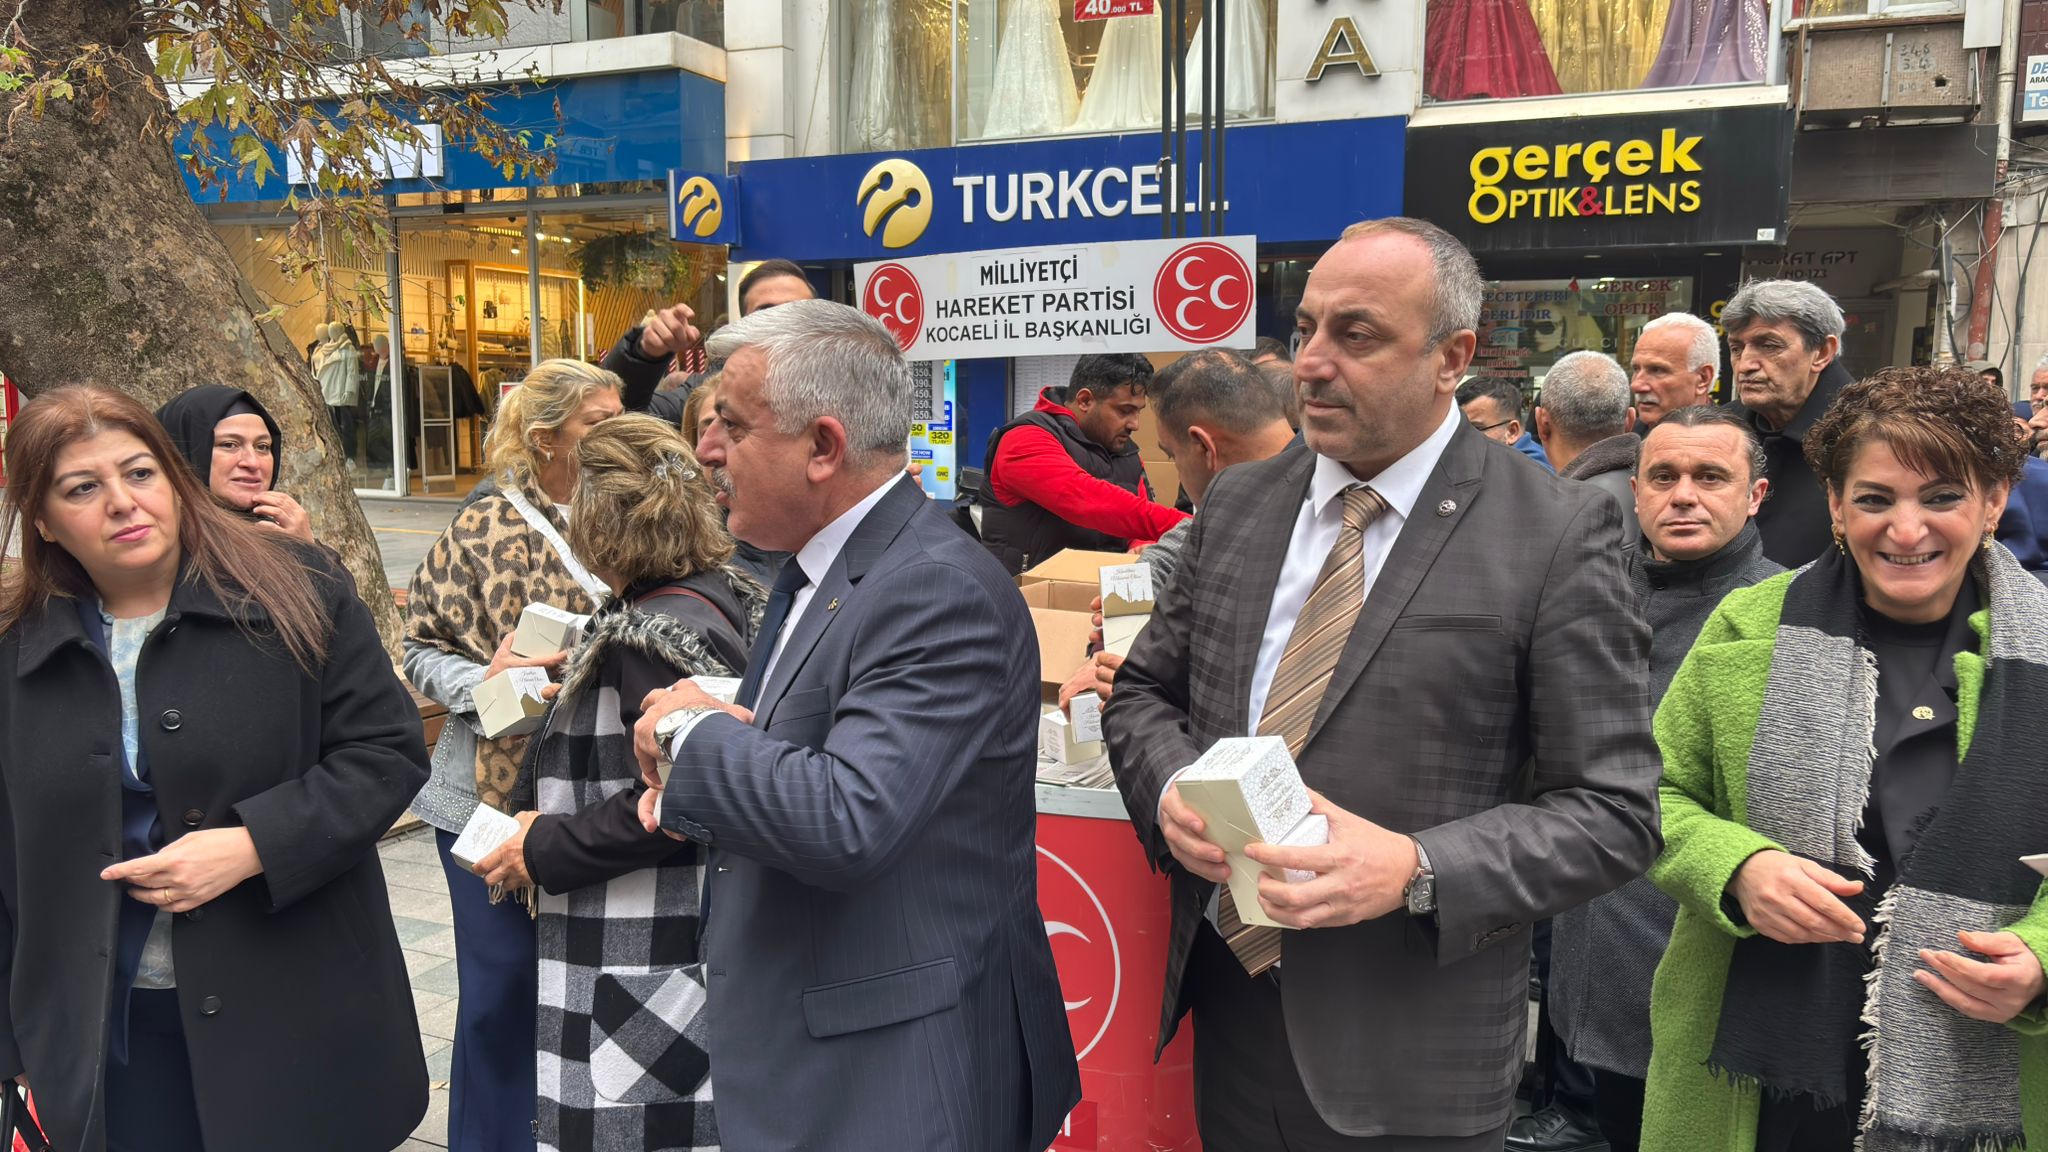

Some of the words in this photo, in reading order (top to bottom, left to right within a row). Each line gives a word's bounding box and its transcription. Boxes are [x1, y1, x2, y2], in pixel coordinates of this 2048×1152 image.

[1129, 3, 1143, 12] TL
[1470, 128, 1703, 190] gerçek
[980, 255, 1078, 286] MİLLİYETÇİ
[936, 294, 1035, 319] HAREKET
[1042, 285, 1135, 313] PARTİSİ
[926, 319, 998, 343] KOCAELİ
[1004, 319, 1020, 339] İL
[1025, 314, 1151, 342] BAŞKANLIĞI
